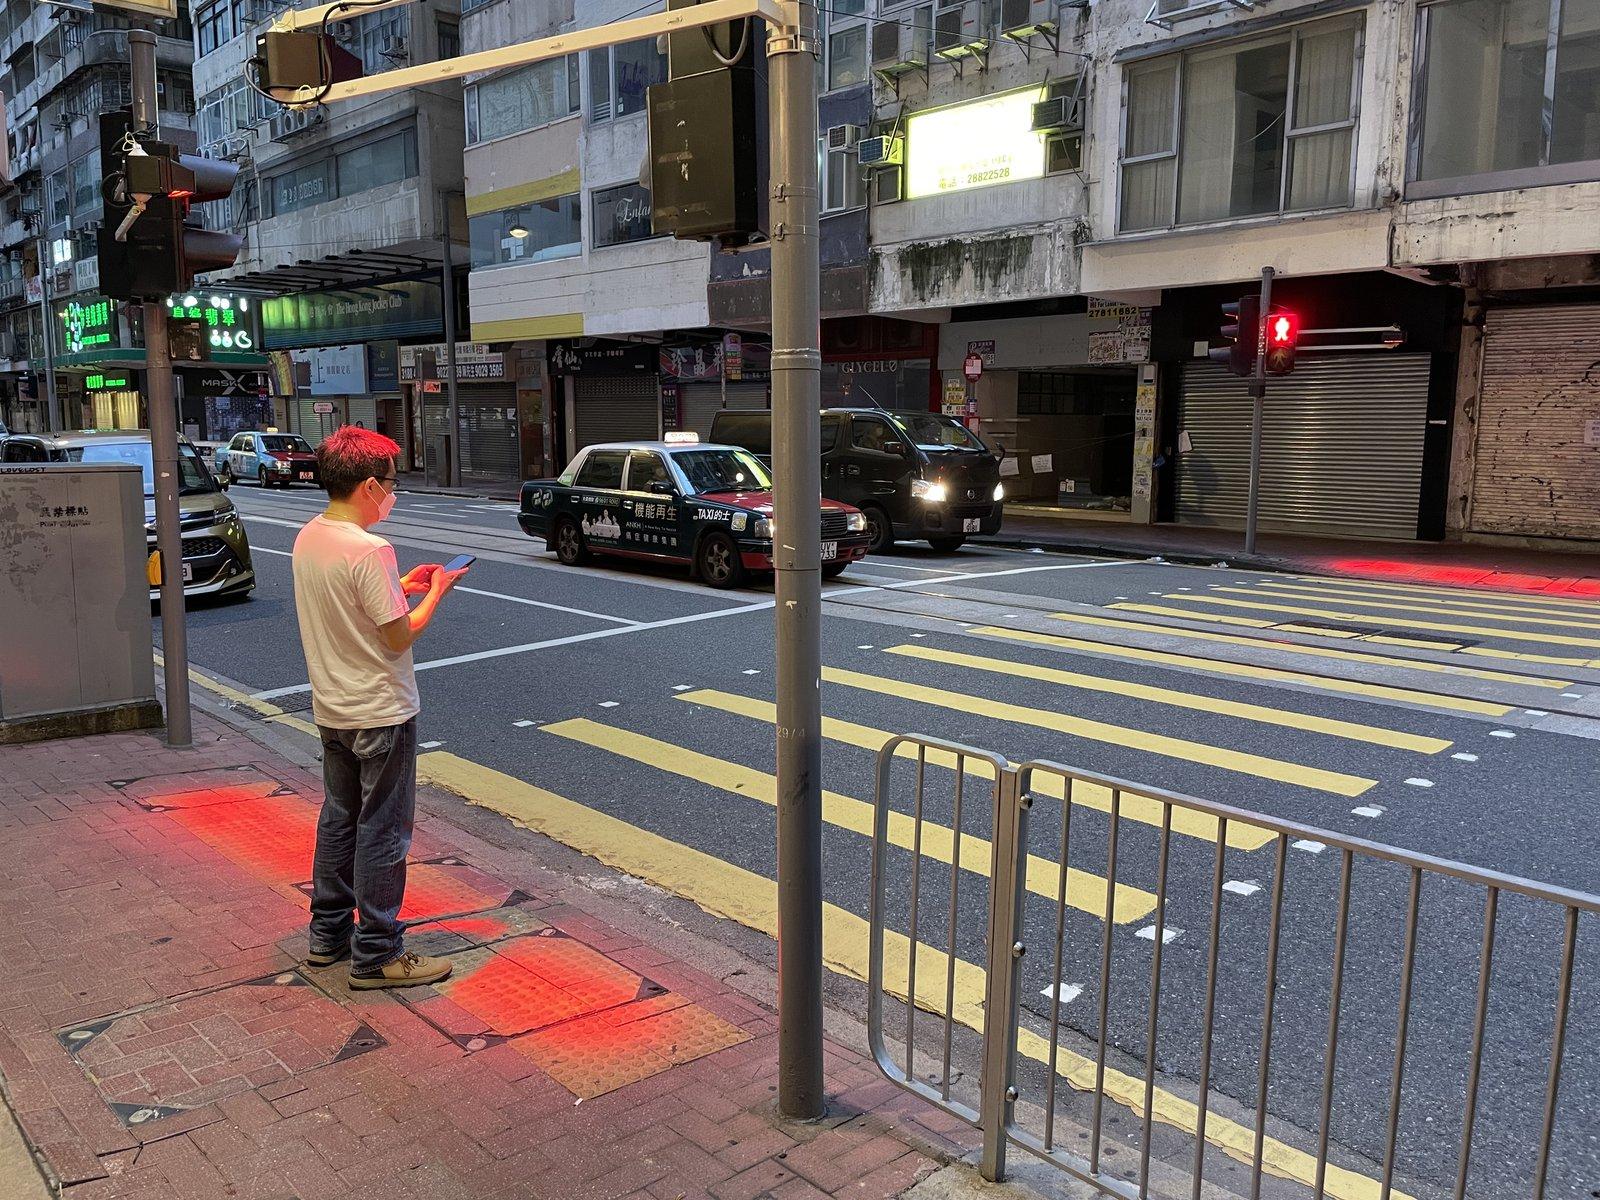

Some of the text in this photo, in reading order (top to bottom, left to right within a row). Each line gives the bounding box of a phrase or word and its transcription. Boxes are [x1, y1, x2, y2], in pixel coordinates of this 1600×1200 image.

[968, 167, 1010, 184] 28822528
[336, 303, 345, 315] The
[389, 294, 402, 308] Club
[842, 361, 887, 374] GLYCEL
[634, 502, 678, 521] 機能再生
[625, 521, 641, 529] ANKH
